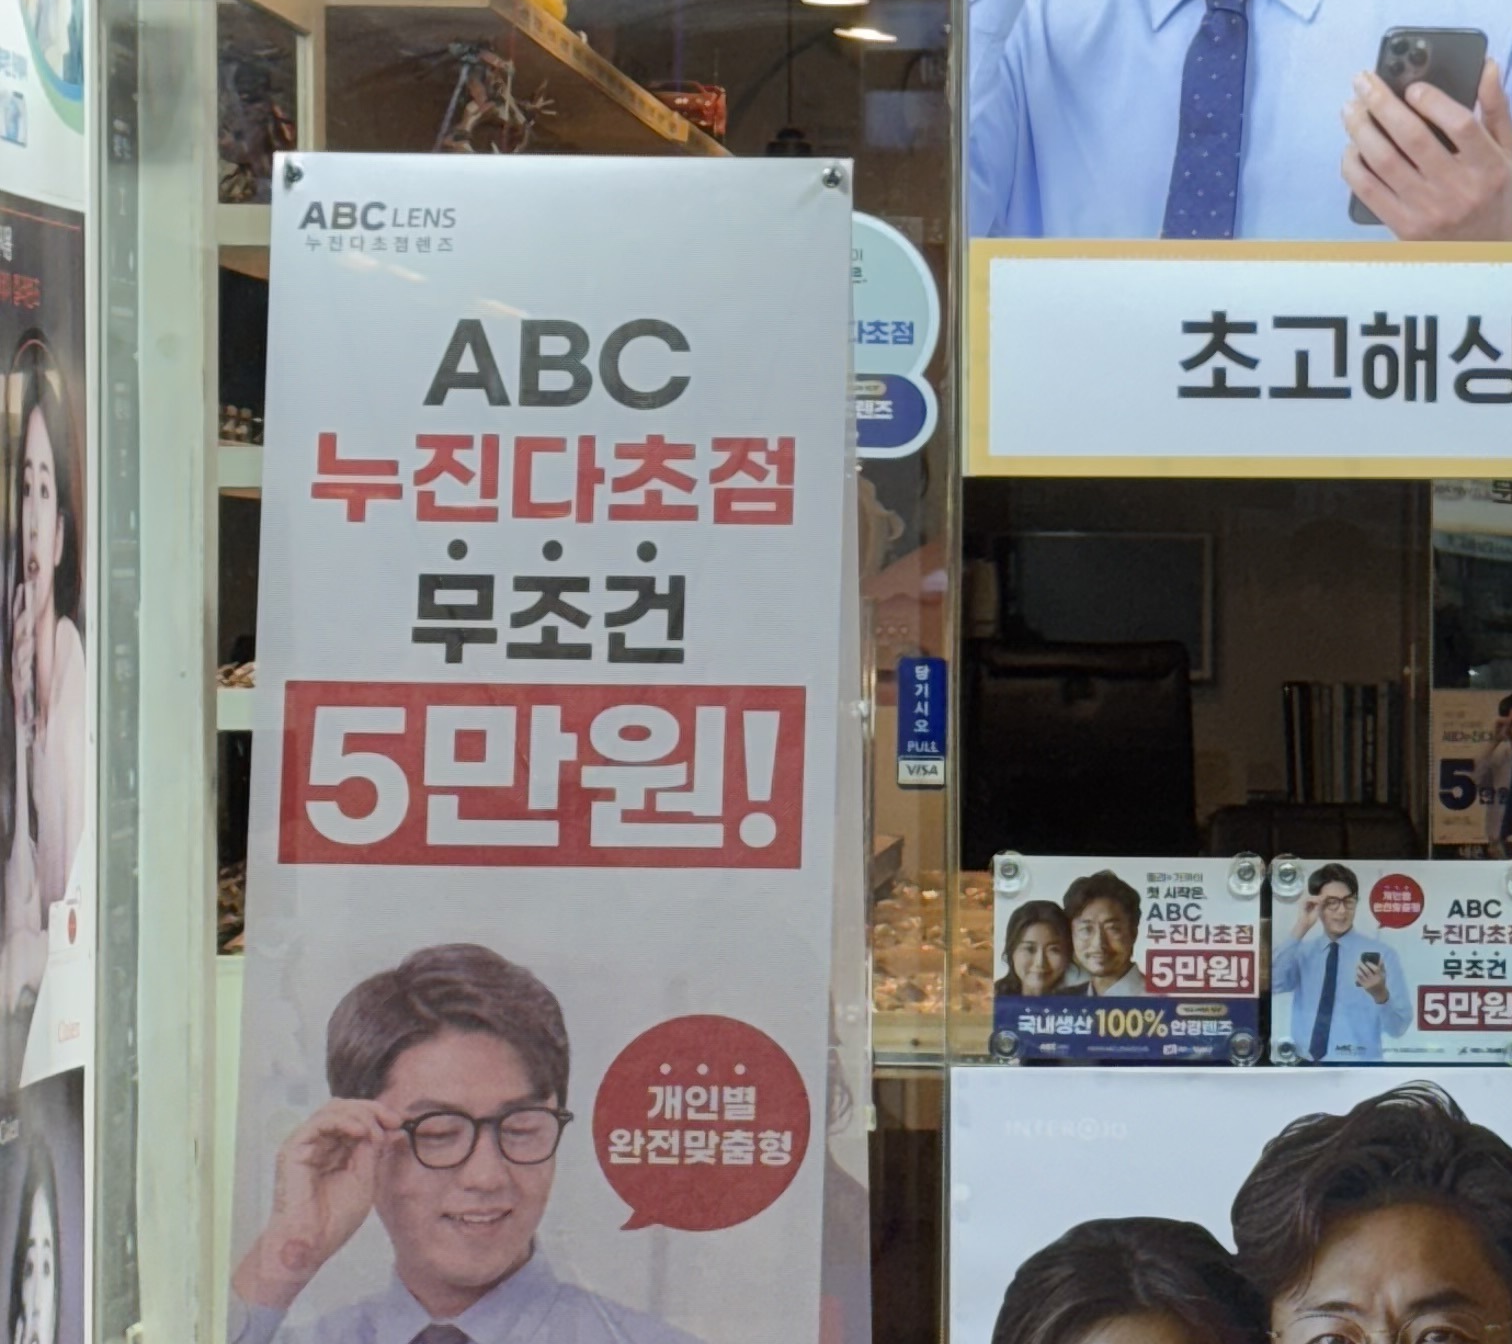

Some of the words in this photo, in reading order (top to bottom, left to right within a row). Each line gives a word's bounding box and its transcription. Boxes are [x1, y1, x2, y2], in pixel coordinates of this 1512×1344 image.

[298, 201, 388, 232] ABC
[391, 207, 457, 229] LENS
[423, 318, 692, 409] ABC
[309, 431, 797, 526] 누진다초점
[411, 572, 686, 664] 무조건
[913, 663, 931, 733] 당기시오
[906, 740, 940, 753] PULL
[305, 702, 782, 850] 5만원!
[905, 763, 939, 777] VISA
[1146, 902, 1203, 923] ABC
[1447, 898, 1503, 919] ABC
[1146, 923, 1255, 945] 누진다초점
[1150, 954, 1251, 989] 5만원!
[1442, 958, 1507, 981] 무조건
[1016, 1011, 1093, 1036] 국내생산
[1094, 1008, 1169, 1039] 100%
[646, 1085, 757, 1121] 개인별
[607, 1128, 793, 1167] 완전맞춤형
